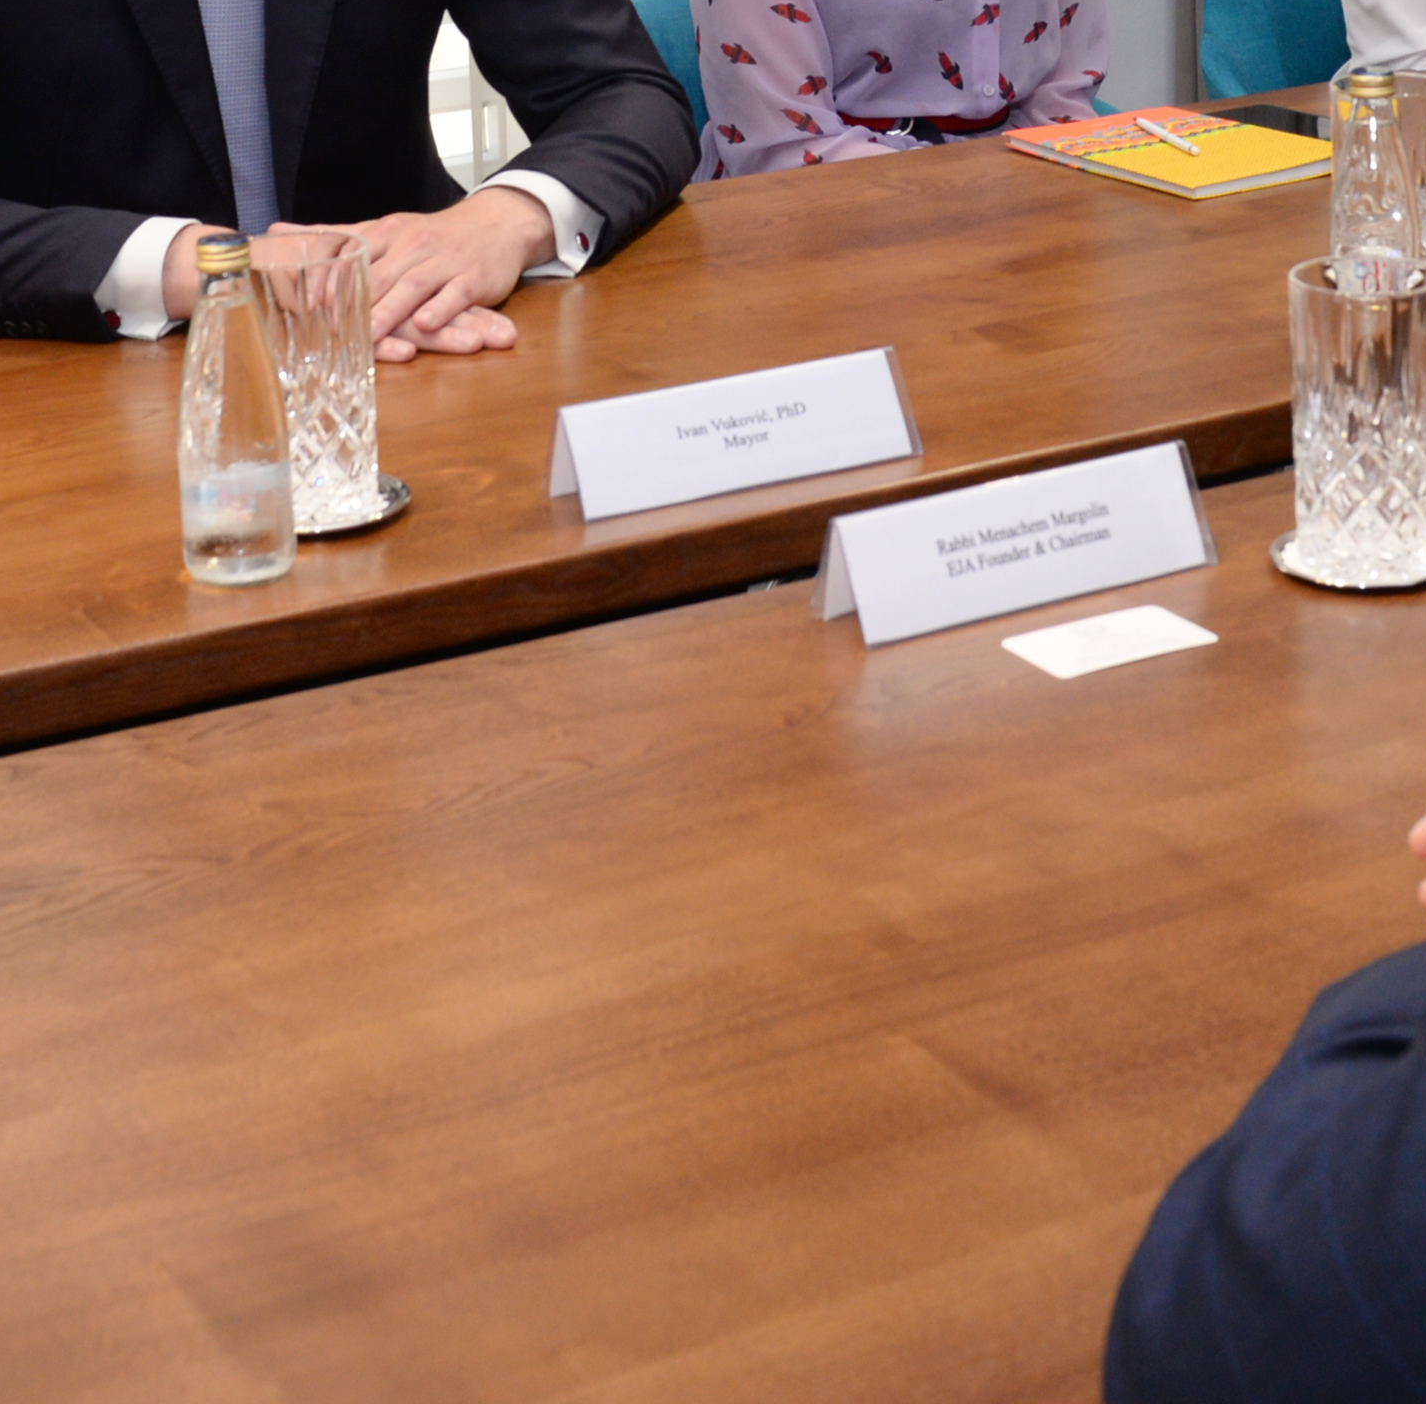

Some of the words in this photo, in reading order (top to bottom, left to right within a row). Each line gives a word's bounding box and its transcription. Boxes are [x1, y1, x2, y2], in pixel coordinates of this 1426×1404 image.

[676, 425, 708, 440] Ivan
[710, 409, 774, 432] Vuković,
[776, 402, 807, 419] PhD
[723, 431, 769, 449] Mayor
[936, 533, 976, 556] Rabbi
[978, 519, 1050, 545] Menachem
[1050, 502, 1110, 527] Margolin
[946, 558, 976, 578] EJA
[976, 546, 1031, 570] Founder
[1033, 540, 1046, 556] &
[1048, 527, 1112, 552] Chairman
